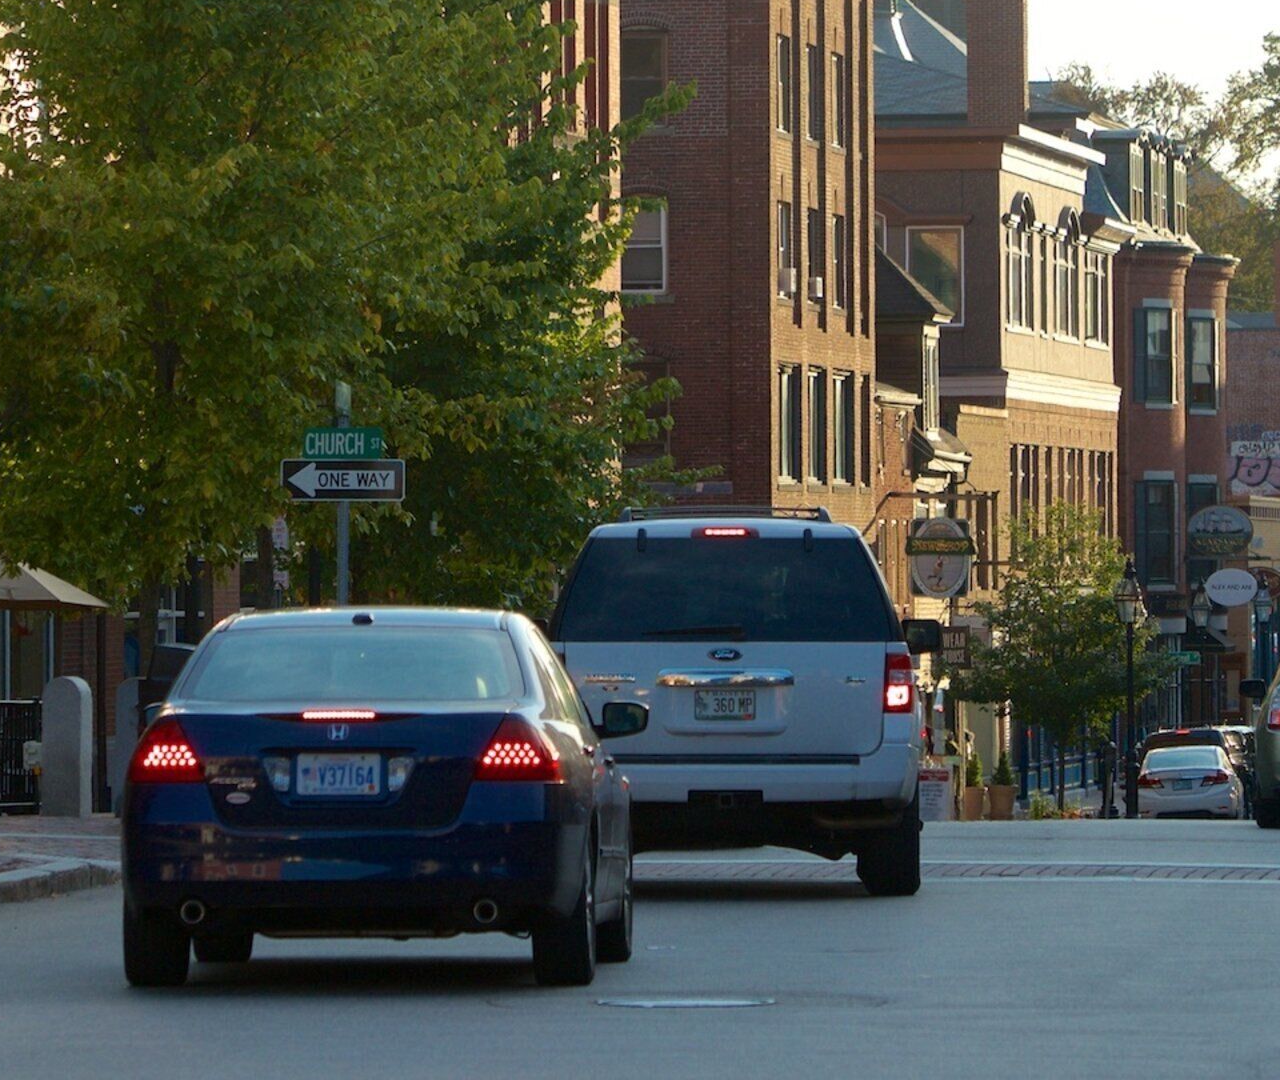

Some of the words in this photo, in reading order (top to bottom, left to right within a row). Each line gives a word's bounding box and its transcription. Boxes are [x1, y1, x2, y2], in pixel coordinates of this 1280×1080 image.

[305, 432, 365, 456] CHURCH
[370, 437, 381, 449] ST
[318, 472, 350, 487] ONE
[356, 472, 390, 487] WAY
[942, 632, 966, 648] WEAR
[713, 697, 735, 713] 360
[738, 697, 753, 713] MP
